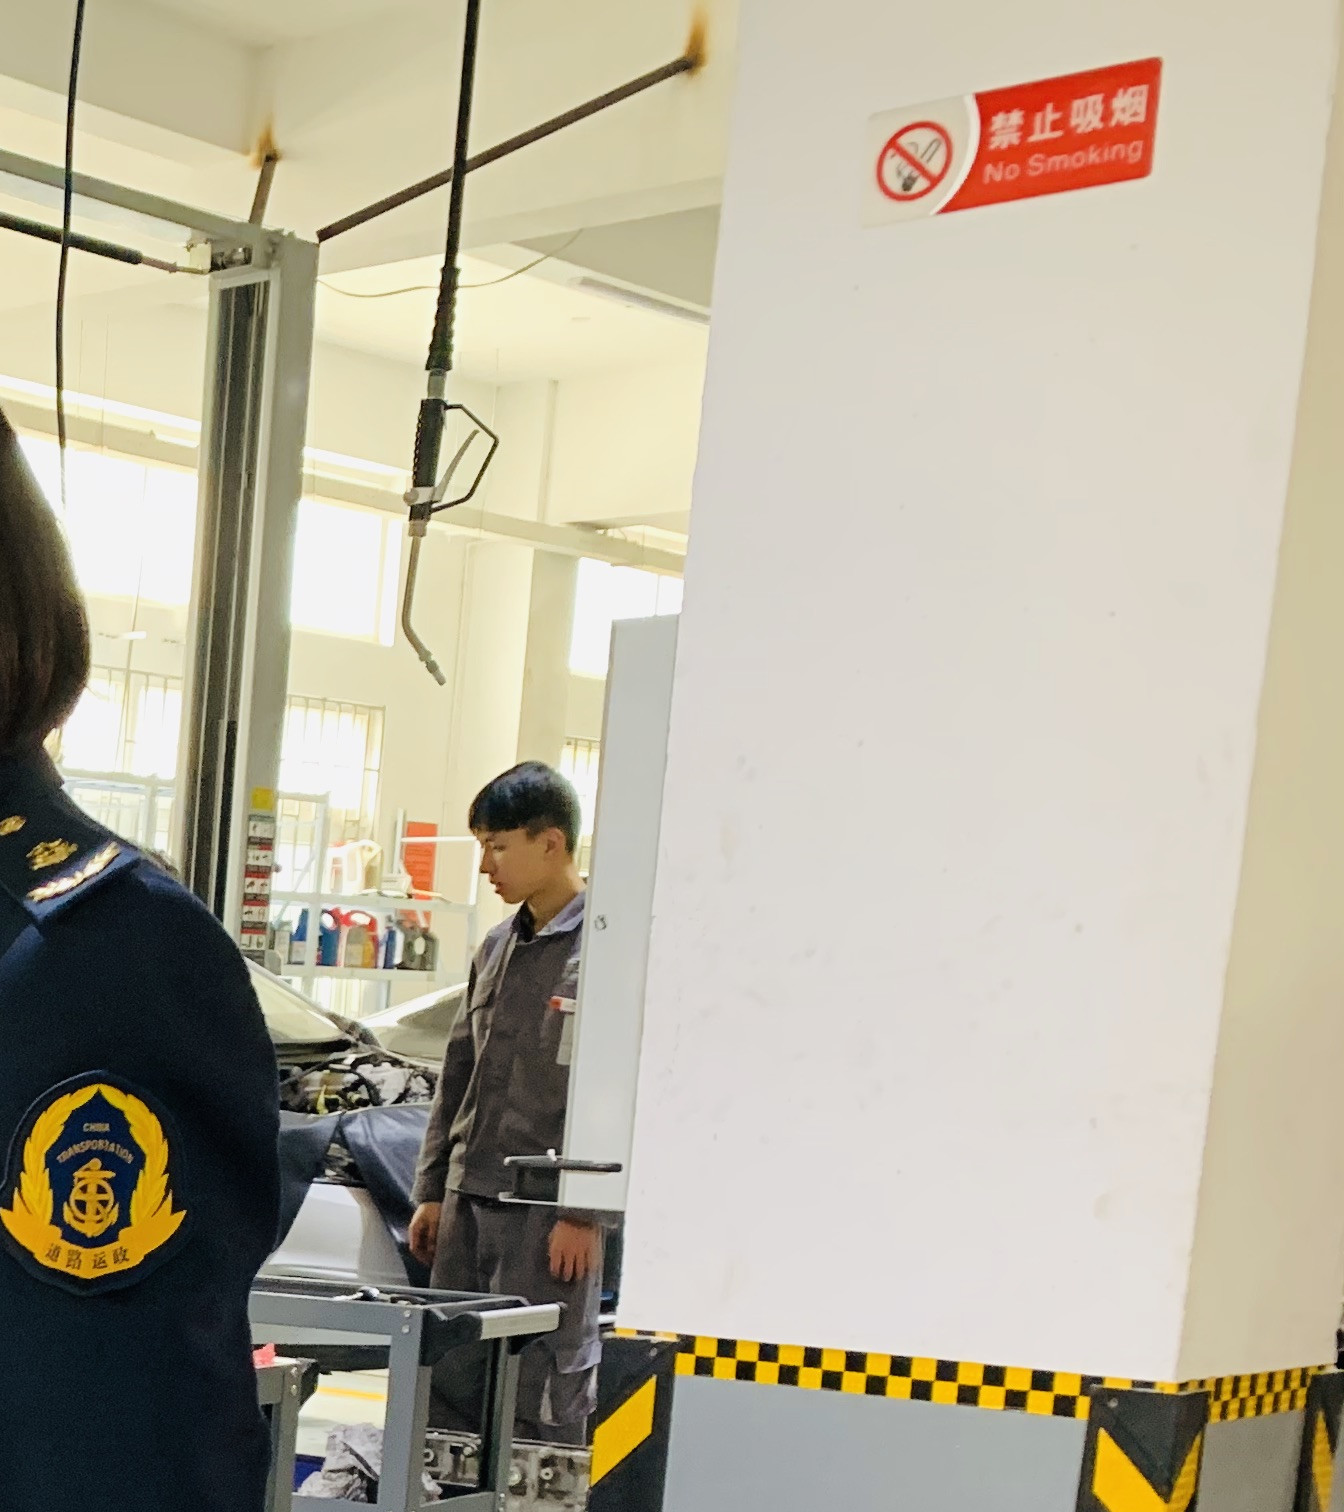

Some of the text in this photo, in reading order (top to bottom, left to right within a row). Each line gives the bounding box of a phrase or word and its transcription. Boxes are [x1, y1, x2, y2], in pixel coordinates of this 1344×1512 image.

[988, 84, 1150, 151] 禁止吸烟
[982, 139, 1145, 184] No Smoking
[45, 1243, 130, 1271] 道路运政
